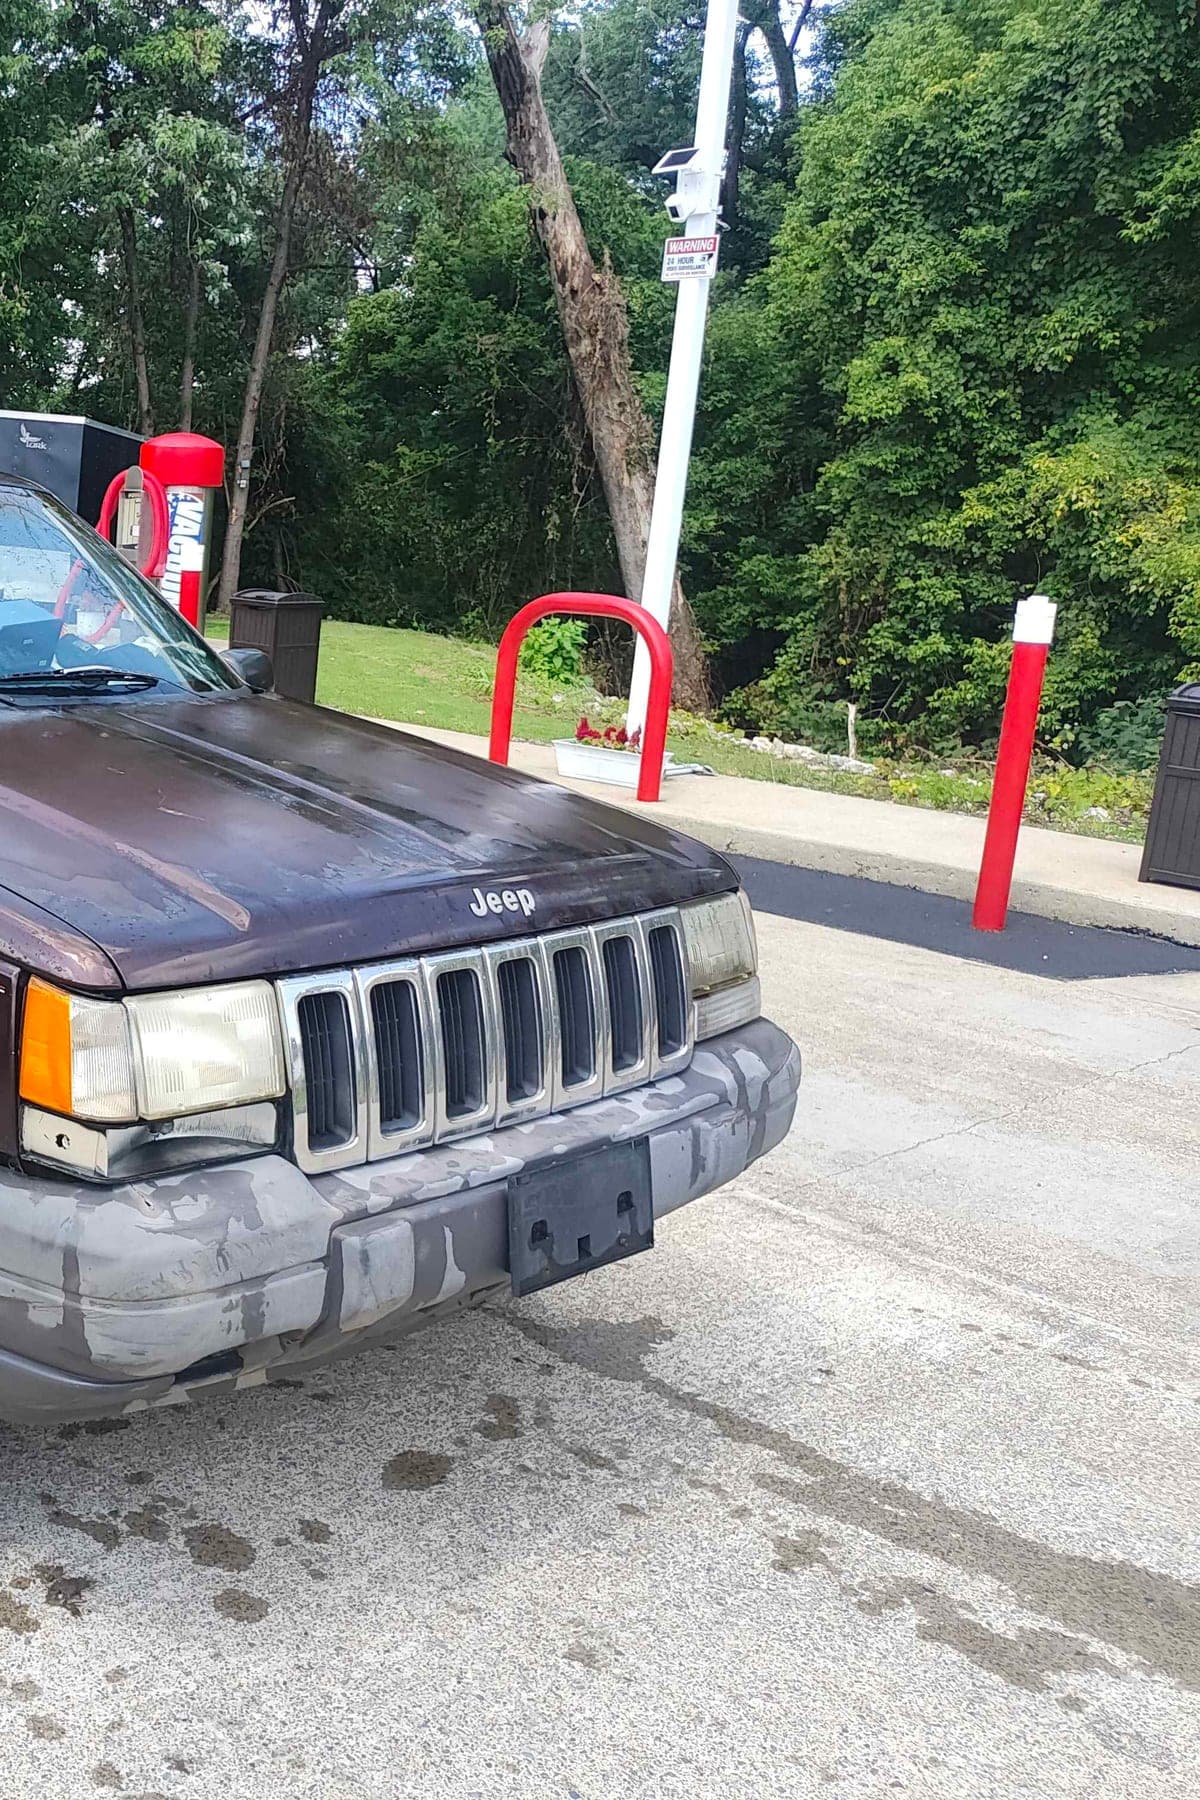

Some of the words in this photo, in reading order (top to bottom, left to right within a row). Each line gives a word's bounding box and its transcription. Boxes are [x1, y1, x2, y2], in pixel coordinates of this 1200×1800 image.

[669, 239, 714, 252] WARNING
[667, 257, 675, 265] 24
[677, 256, 695, 265] HOUR
[469, 887, 536, 917] Jeep
